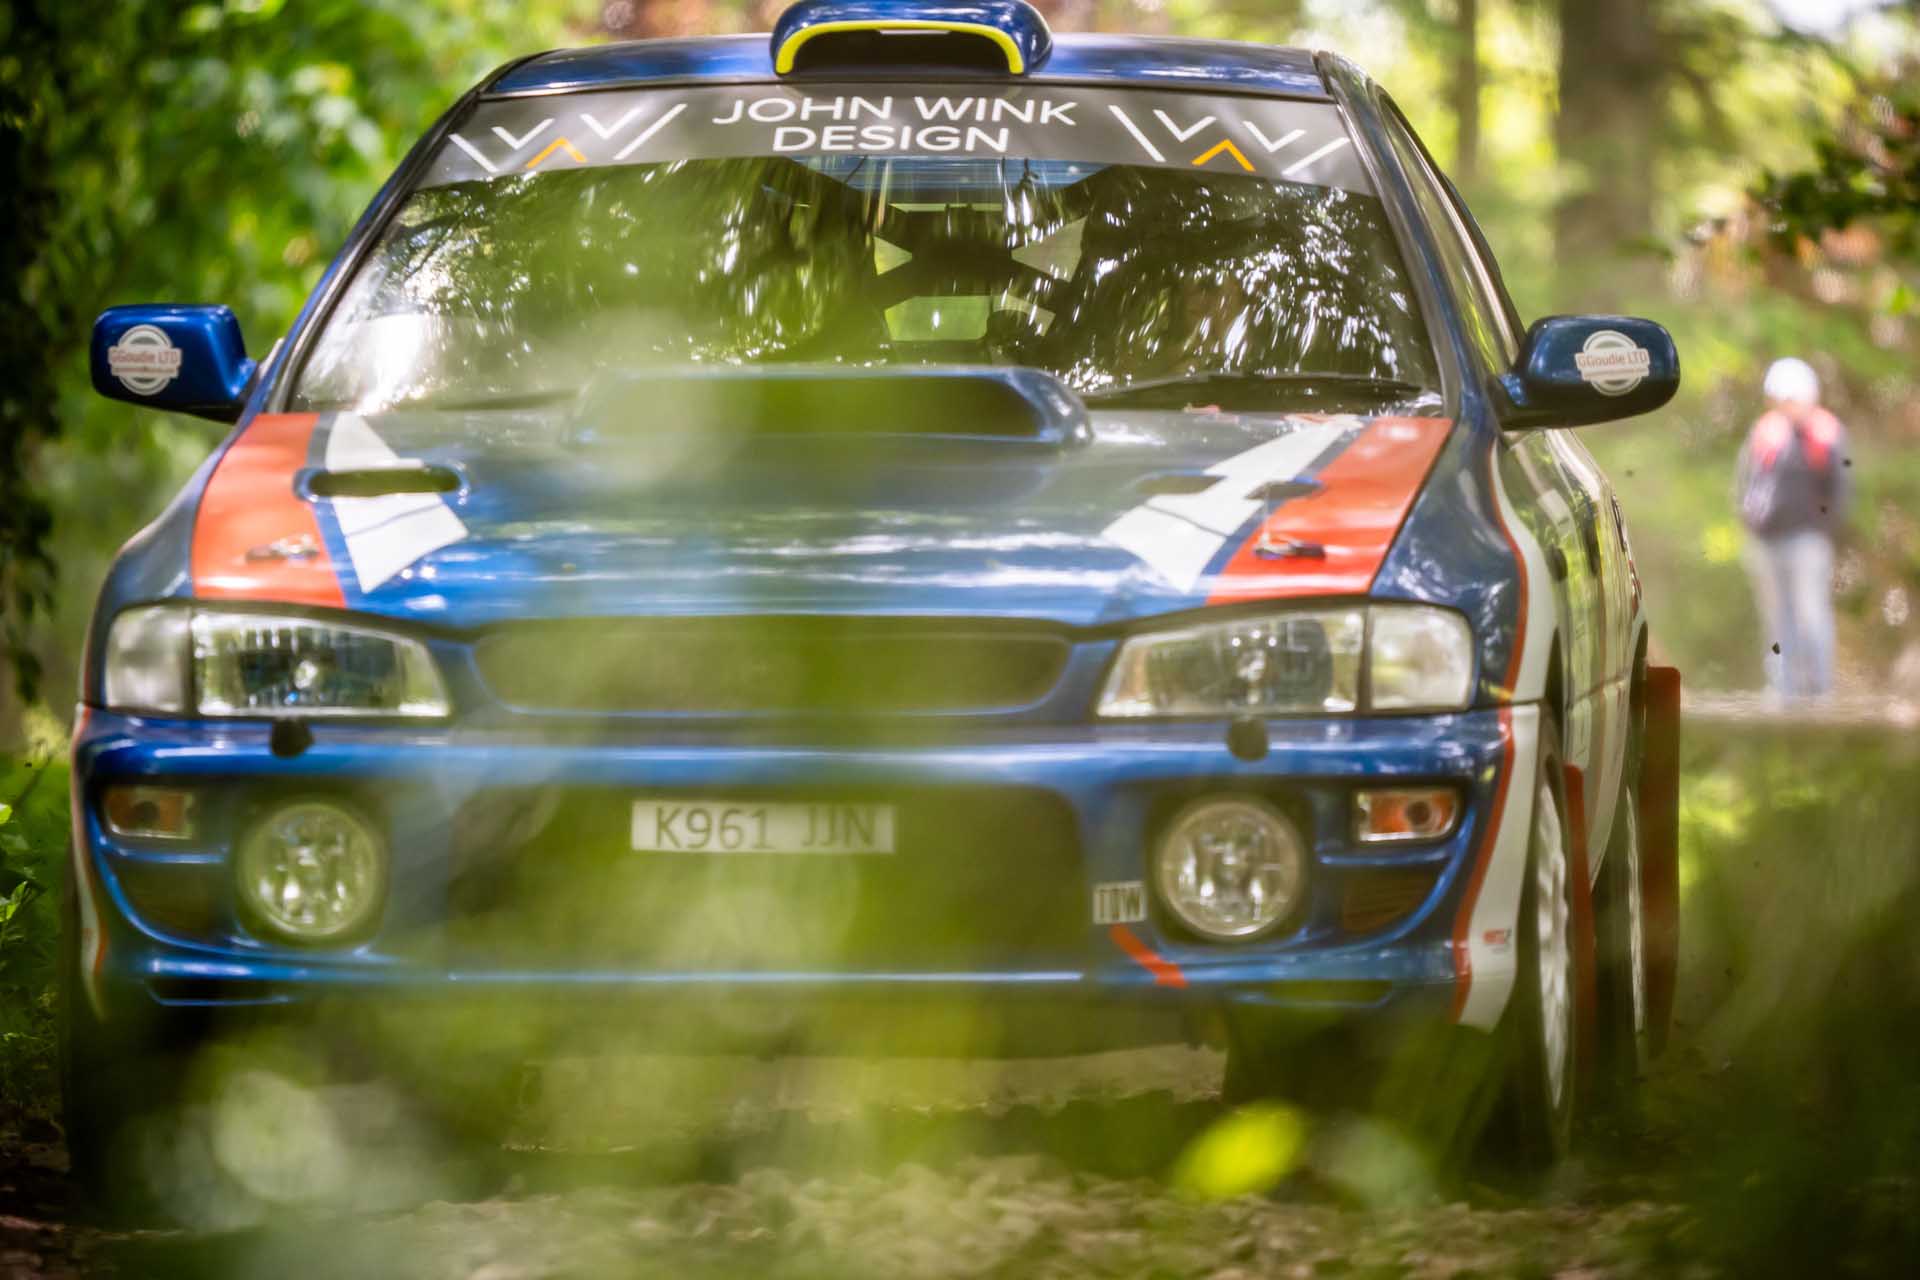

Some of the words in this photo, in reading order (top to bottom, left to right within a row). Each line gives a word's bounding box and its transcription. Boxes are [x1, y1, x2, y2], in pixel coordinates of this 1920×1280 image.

[712, 96, 893, 125] JOHN
[914, 96, 1078, 126] WINK
[772, 125, 1009, 152] DESIGN
[1627, 350, 1647, 364] LTD
[655, 807, 777, 850] K961
[801, 805, 877, 849] JJN
